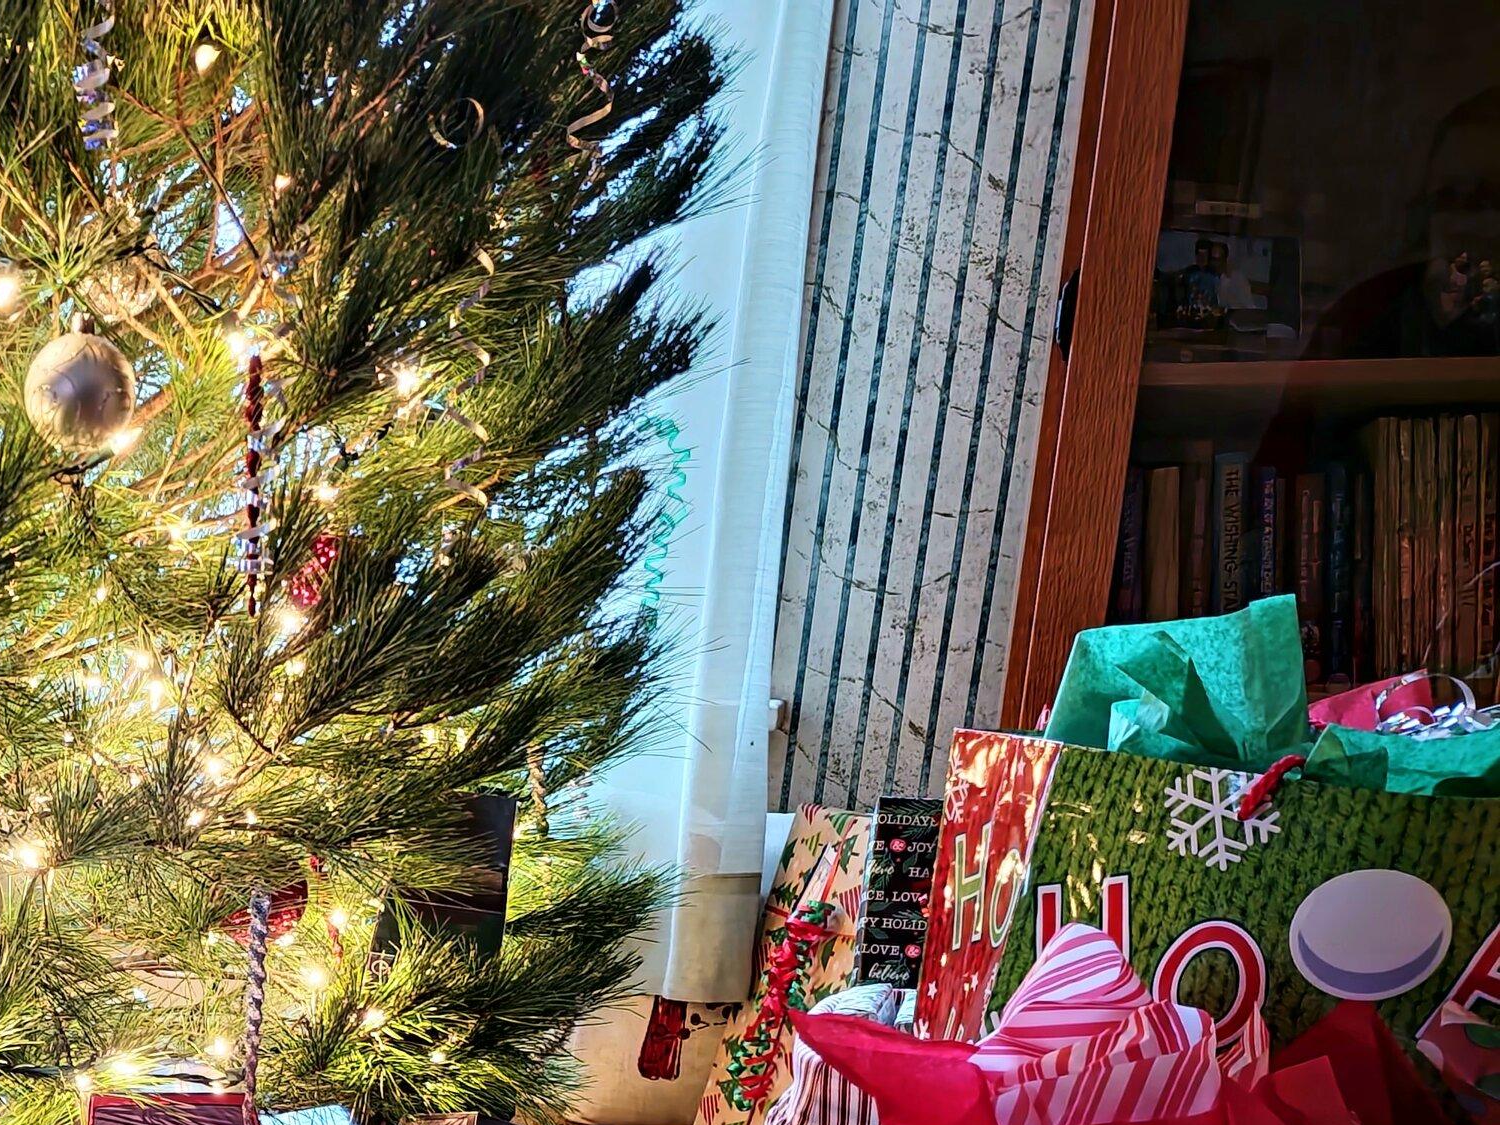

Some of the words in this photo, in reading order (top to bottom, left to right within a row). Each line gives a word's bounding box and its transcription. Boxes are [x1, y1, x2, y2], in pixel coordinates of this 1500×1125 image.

[1225, 470, 1239, 497] THE
[1224, 504, 1240, 576] WISHING
[907, 841, 936, 853] JOY
[881, 917, 928, 931] HOLID
